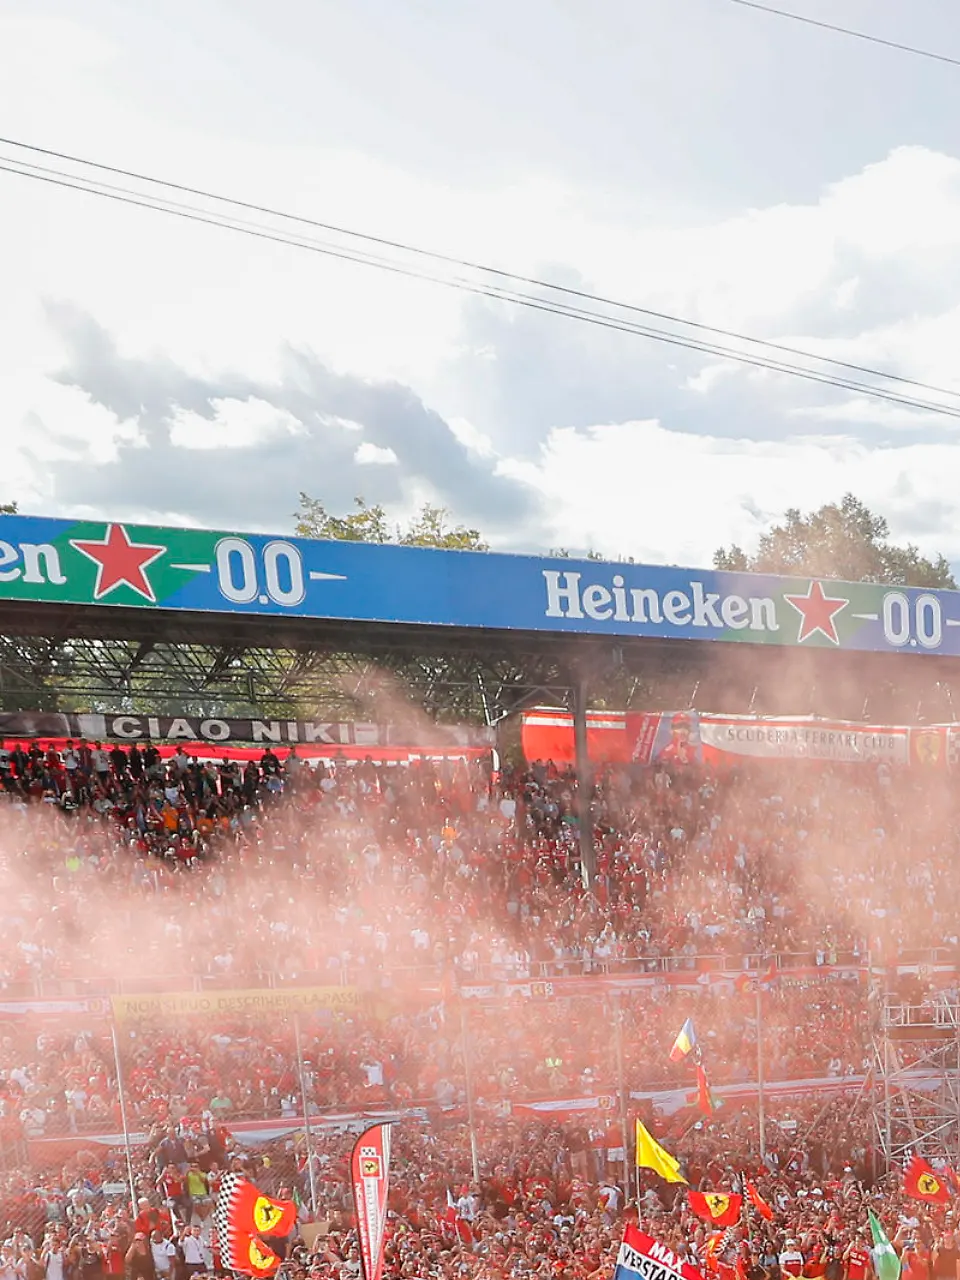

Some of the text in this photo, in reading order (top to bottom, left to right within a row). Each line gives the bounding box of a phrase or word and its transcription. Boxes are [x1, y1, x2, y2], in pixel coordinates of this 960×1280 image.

[214, 537, 306, 607] 0.0
[542, 570, 942, 648] Heineken 0.0
[111, 717, 350, 745] CIAO NIKI
[727, 728, 896, 750] SCUDERIA FERRARI CLUB
[647, 1241, 685, 1274] MAX
